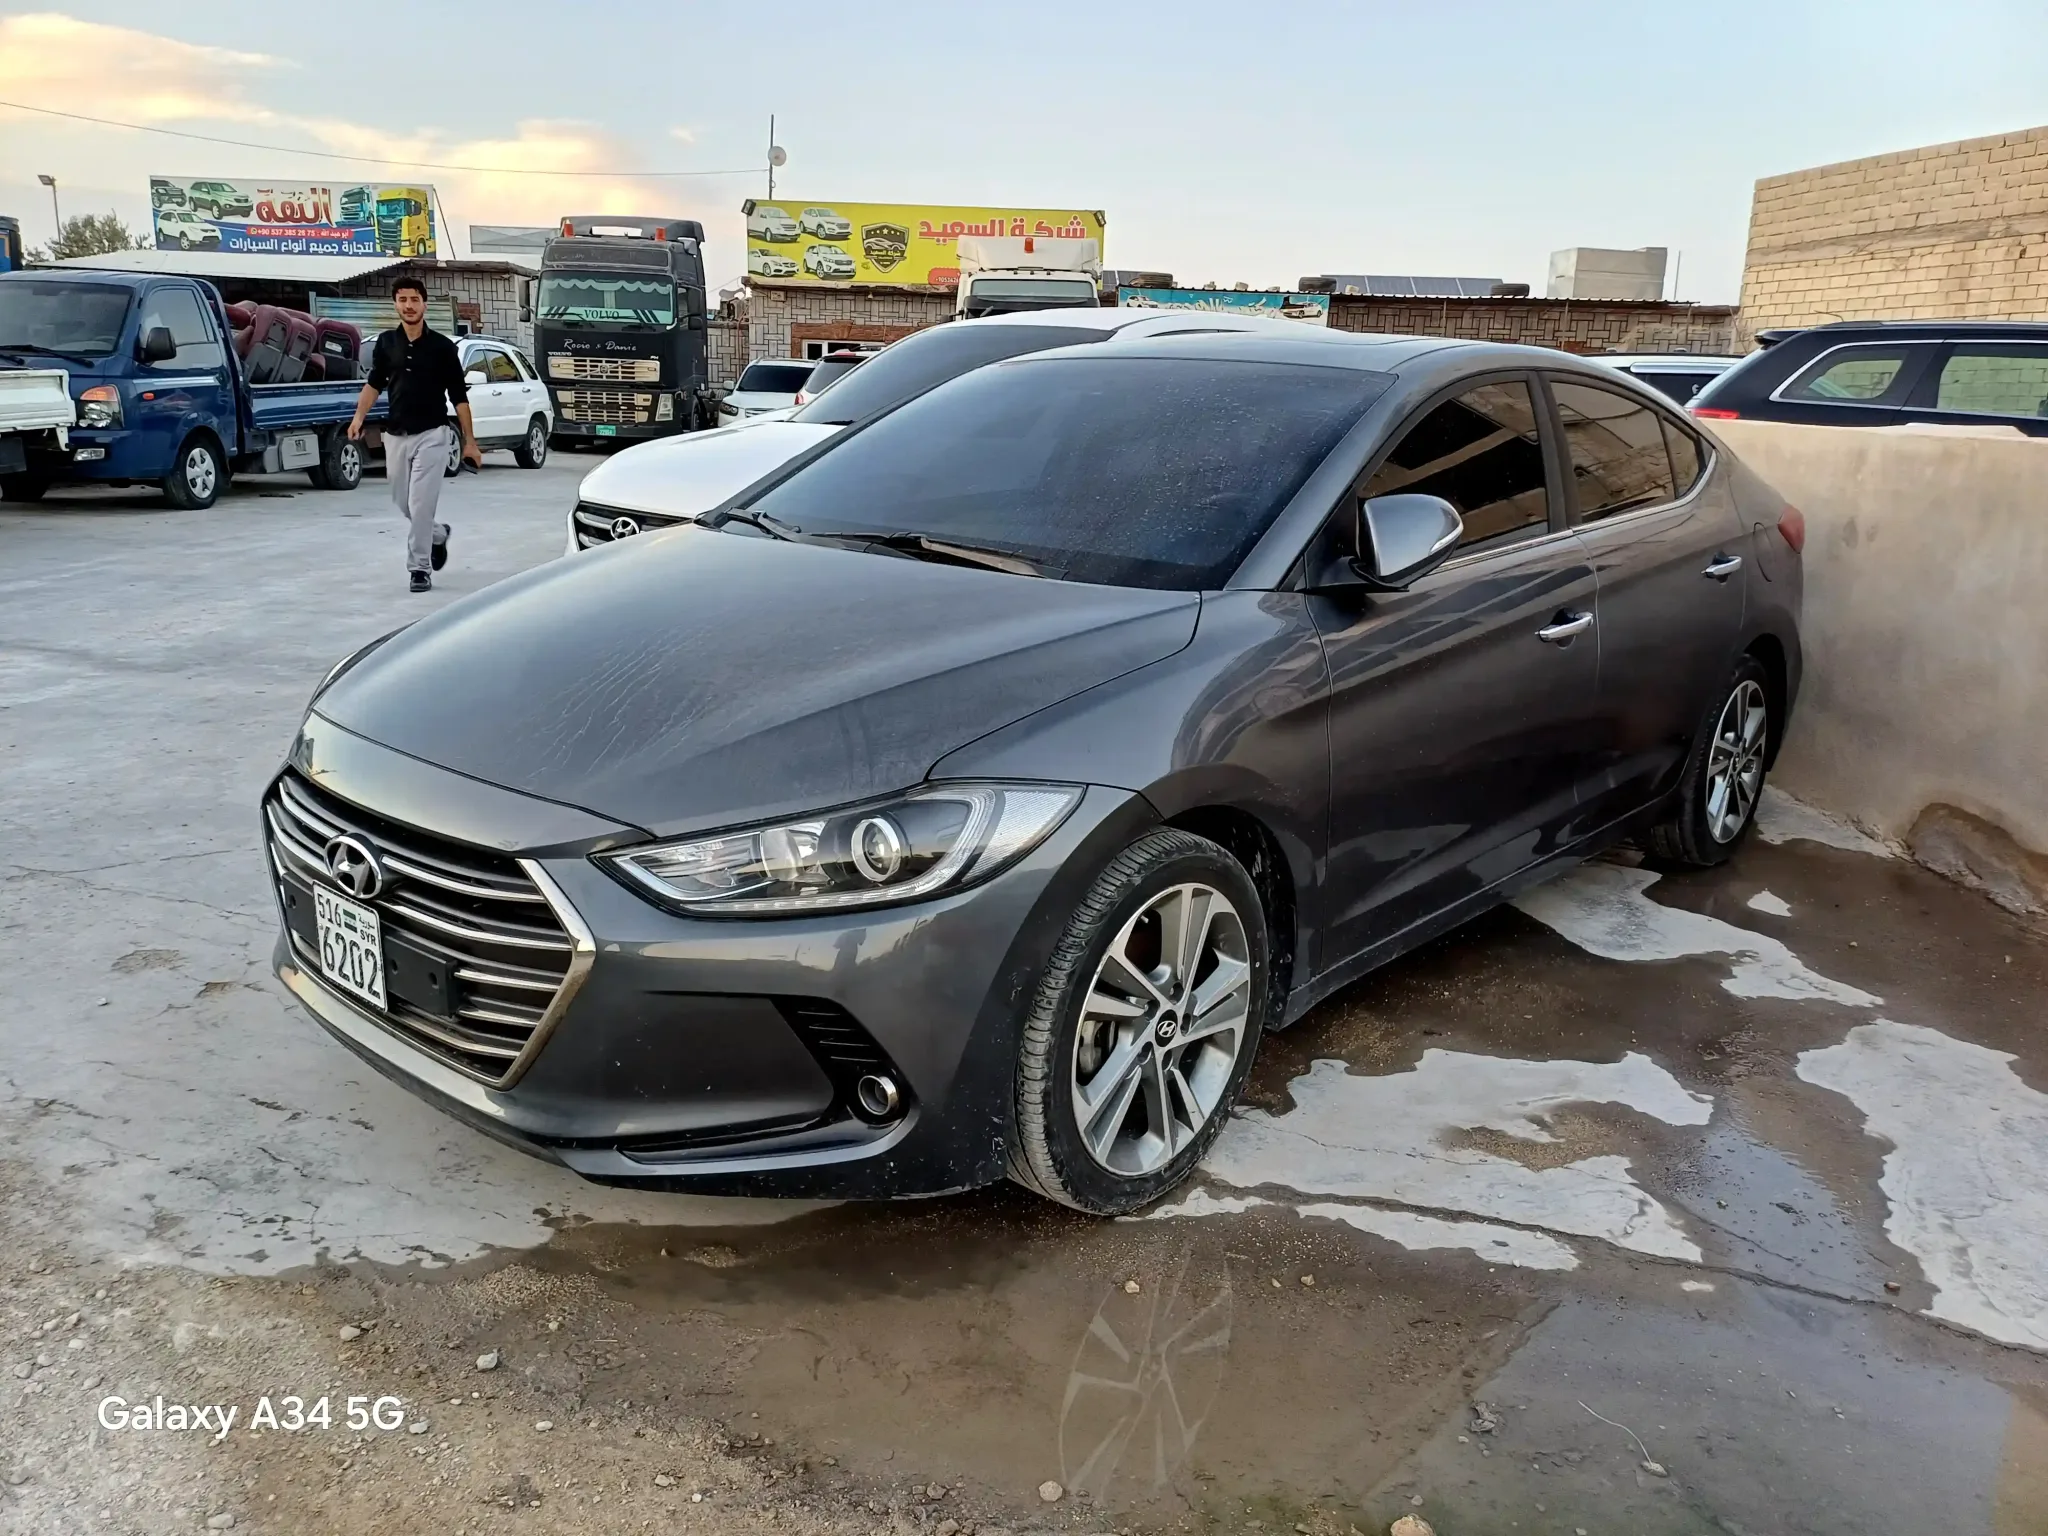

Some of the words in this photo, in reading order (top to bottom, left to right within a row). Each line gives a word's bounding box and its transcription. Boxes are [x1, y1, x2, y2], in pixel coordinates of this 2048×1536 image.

[918, 219, 1004, 245] السعيد
[229, 237, 278, 252] السيارات
[309, 242, 339, 254] جميع
[342, 240, 373, 255] لتجارة
[584, 309, 620, 319] VOLVO
[317, 893, 341, 928] 516
[360, 929, 377, 947] SYR
[323, 926, 380, 1000] 6202
